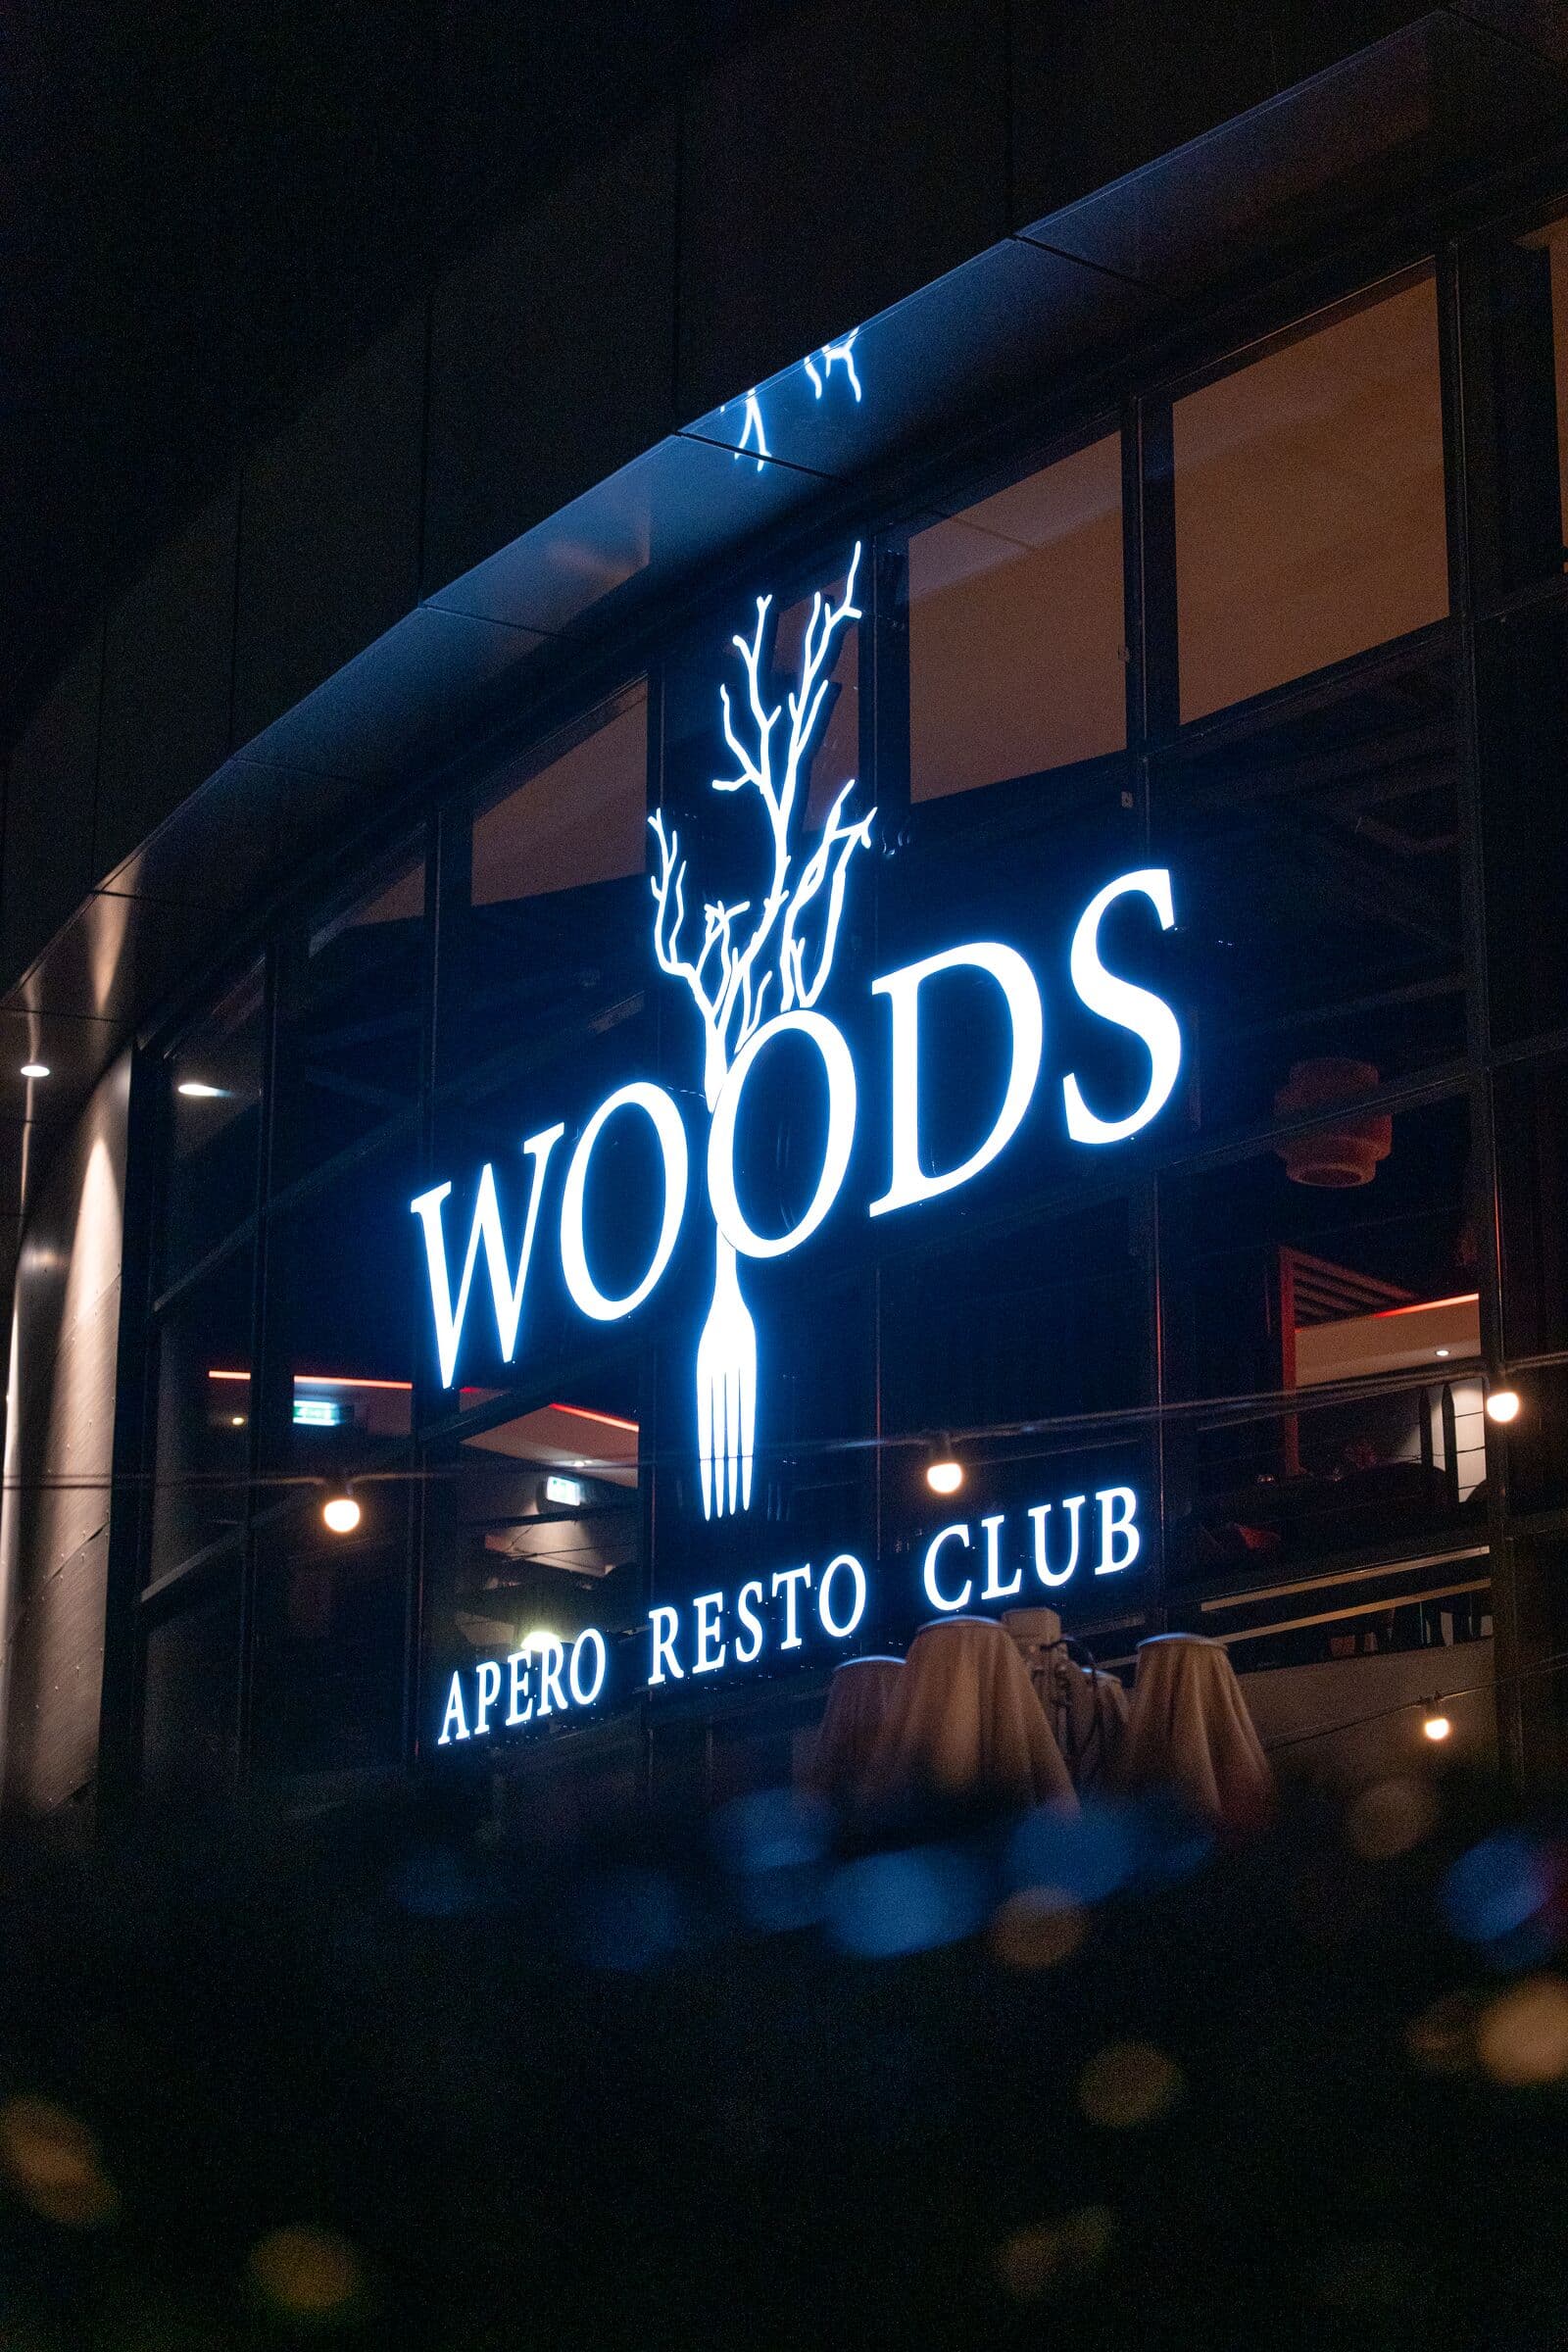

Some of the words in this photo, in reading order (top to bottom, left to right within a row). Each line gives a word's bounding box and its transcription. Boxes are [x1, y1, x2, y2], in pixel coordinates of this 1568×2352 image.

[411, 868, 1182, 1389] WOODS
[437, 1628, 606, 1744] APERO
[648, 1554, 866, 1686] RESTO
[923, 1487, 1140, 1610] CLUB
